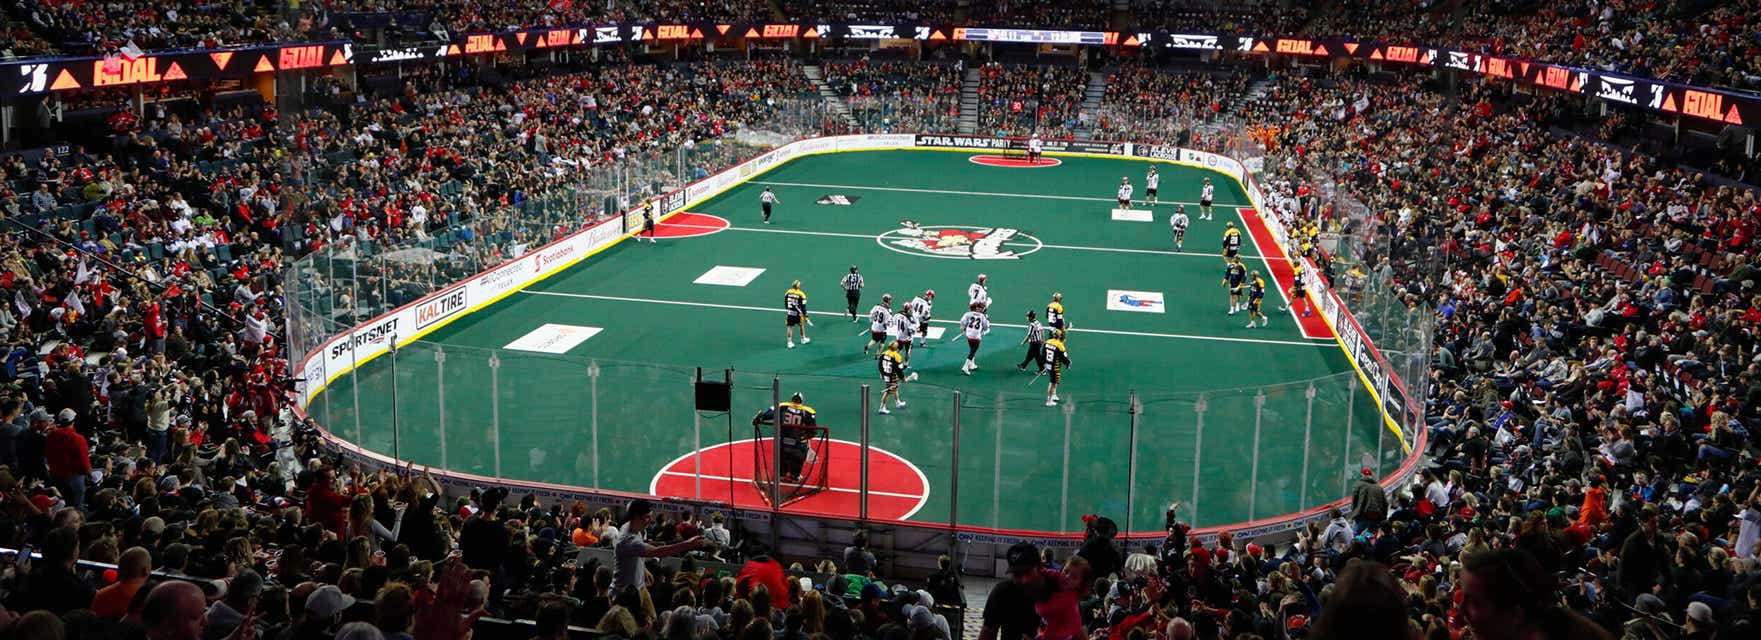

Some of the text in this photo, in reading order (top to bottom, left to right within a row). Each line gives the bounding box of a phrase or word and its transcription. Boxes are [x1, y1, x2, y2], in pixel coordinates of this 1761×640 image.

[657, 25, 690, 39] GOAL
[1276, 39, 1313, 54] GOAL
[1683, 90, 1724, 120] GOAL
[917, 136, 953, 146] STAR
[953, 137, 991, 148] WARS
[543, 244, 574, 265] Scotiabank
[969, 316, 981, 330] 23
[332, 318, 399, 360] SPORTSNET
